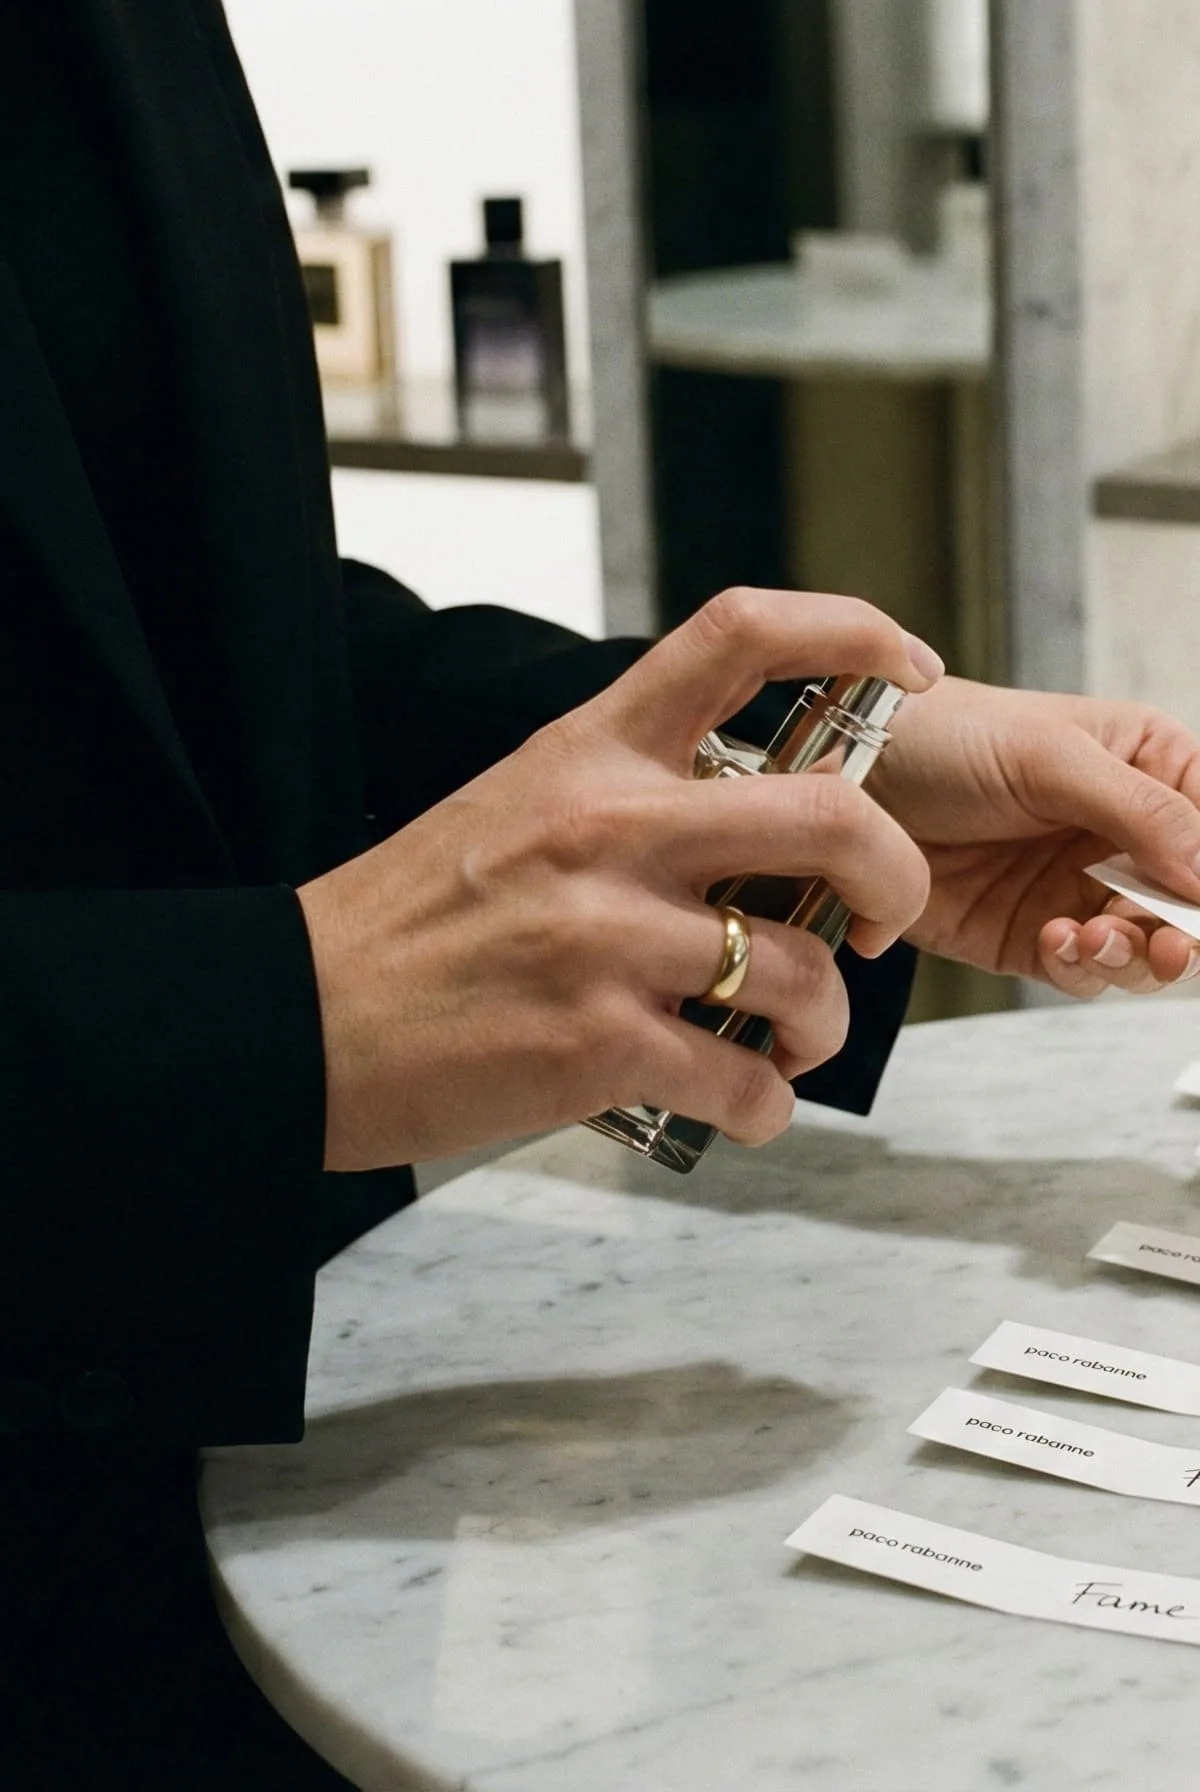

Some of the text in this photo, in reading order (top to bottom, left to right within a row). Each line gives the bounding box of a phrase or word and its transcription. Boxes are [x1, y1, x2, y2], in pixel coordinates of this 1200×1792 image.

[1138, 1244, 1182, 1257] paco
[1023, 1346, 1148, 1380] paco rabanne
[965, 1417, 1095, 1457] paco rabanne
[848, 1528, 984, 1572] paco rabanne
[1071, 1582, 1198, 1618] Fame
